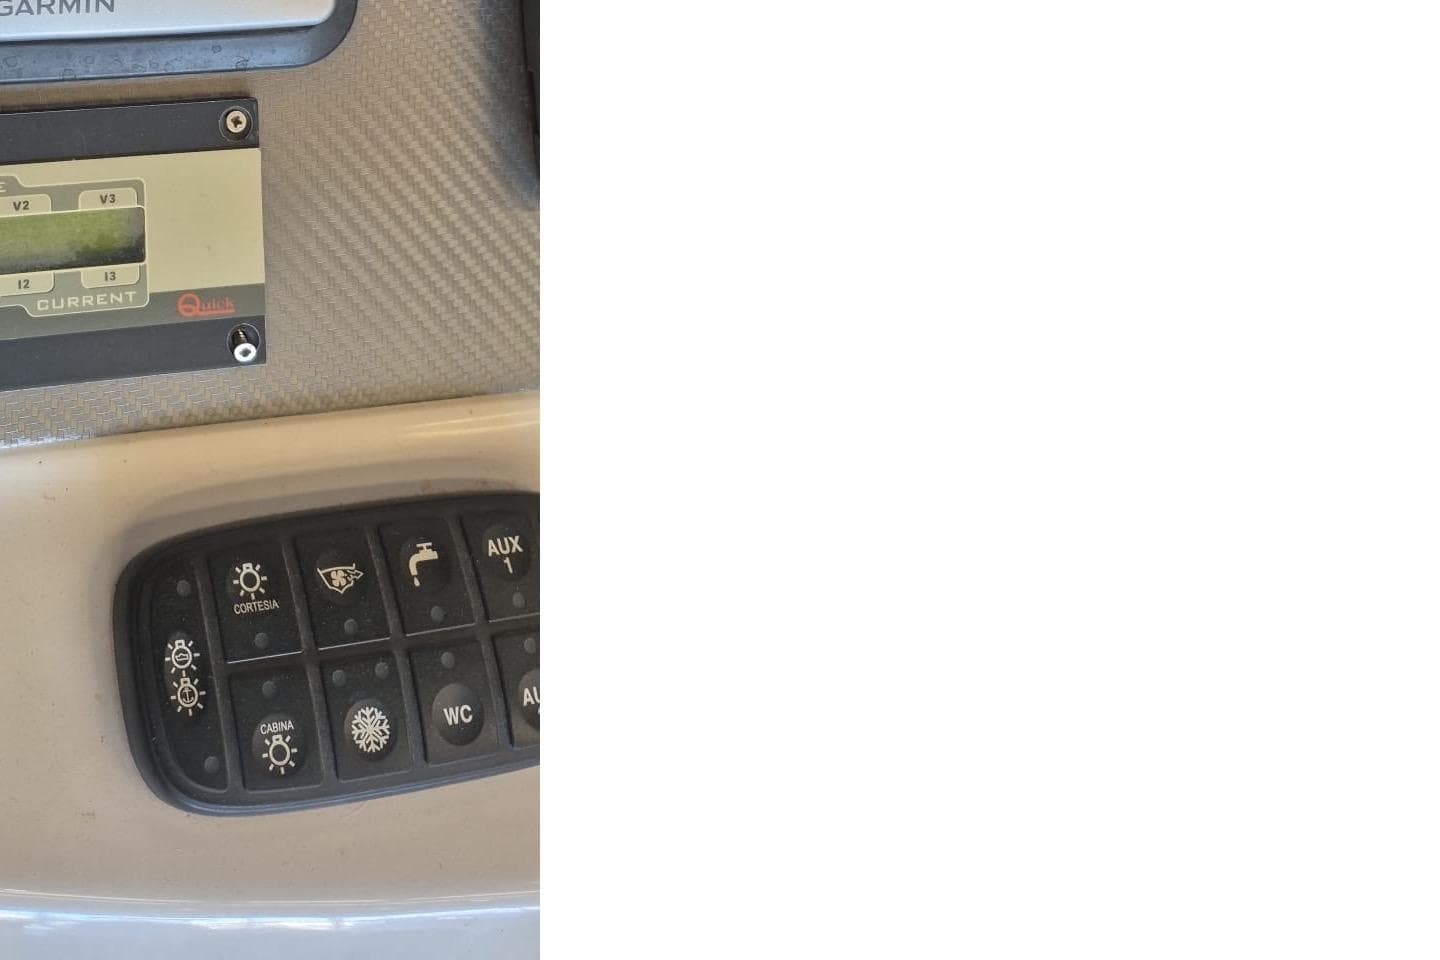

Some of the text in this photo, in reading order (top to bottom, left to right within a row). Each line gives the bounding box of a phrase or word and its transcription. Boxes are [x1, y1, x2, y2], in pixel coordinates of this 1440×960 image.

[13, 200, 30, 211] V2
[99, 194, 116, 204] V3
[105, 271, 116, 281] I3
[18, 279, 30, 289] I2
[37, 291, 137, 311] CURRENT
[177, 292, 235, 316] Quick
[488, 536, 523, 557] AUX
[503, 557, 513, 573] 1
[234, 600, 279, 614] CORTESIA
[443, 704, 473, 726] WC
[260, 720, 295, 734] CABINA
